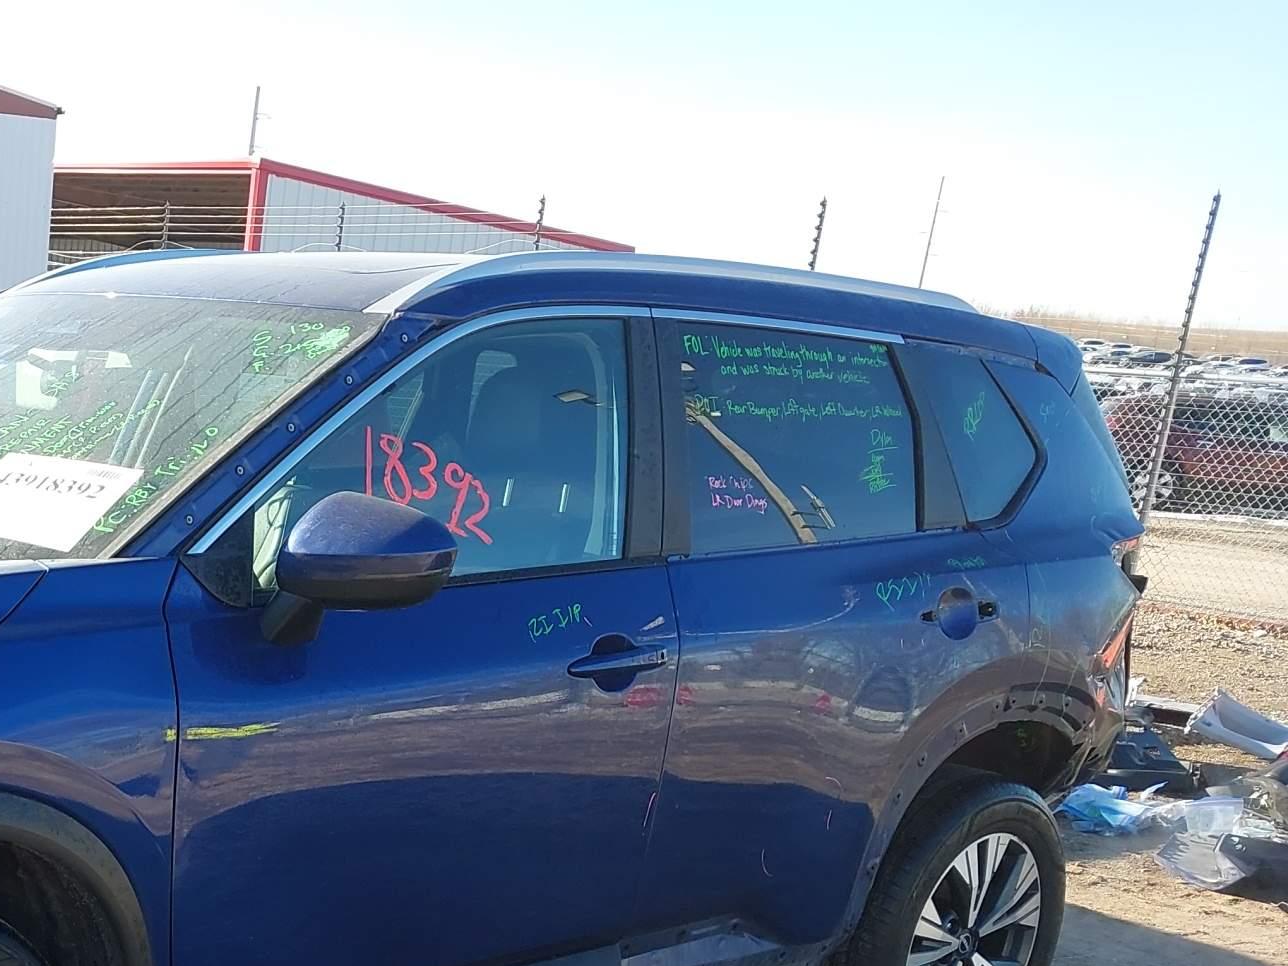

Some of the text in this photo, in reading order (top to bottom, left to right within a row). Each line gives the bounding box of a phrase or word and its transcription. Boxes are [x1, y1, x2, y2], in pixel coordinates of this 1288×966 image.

[712, 336, 743, 358] Vehicle
[745, 345, 763, 358] was
[721, 361, 738, 376] and
[741, 363, 759, 376] was
[792, 366, 804, 384] by
[806, 367, 833, 380] another
[726, 400, 746, 417] Rear
[125, 482, 158, 506] RBY
[365, 425, 494, 545] 18392
